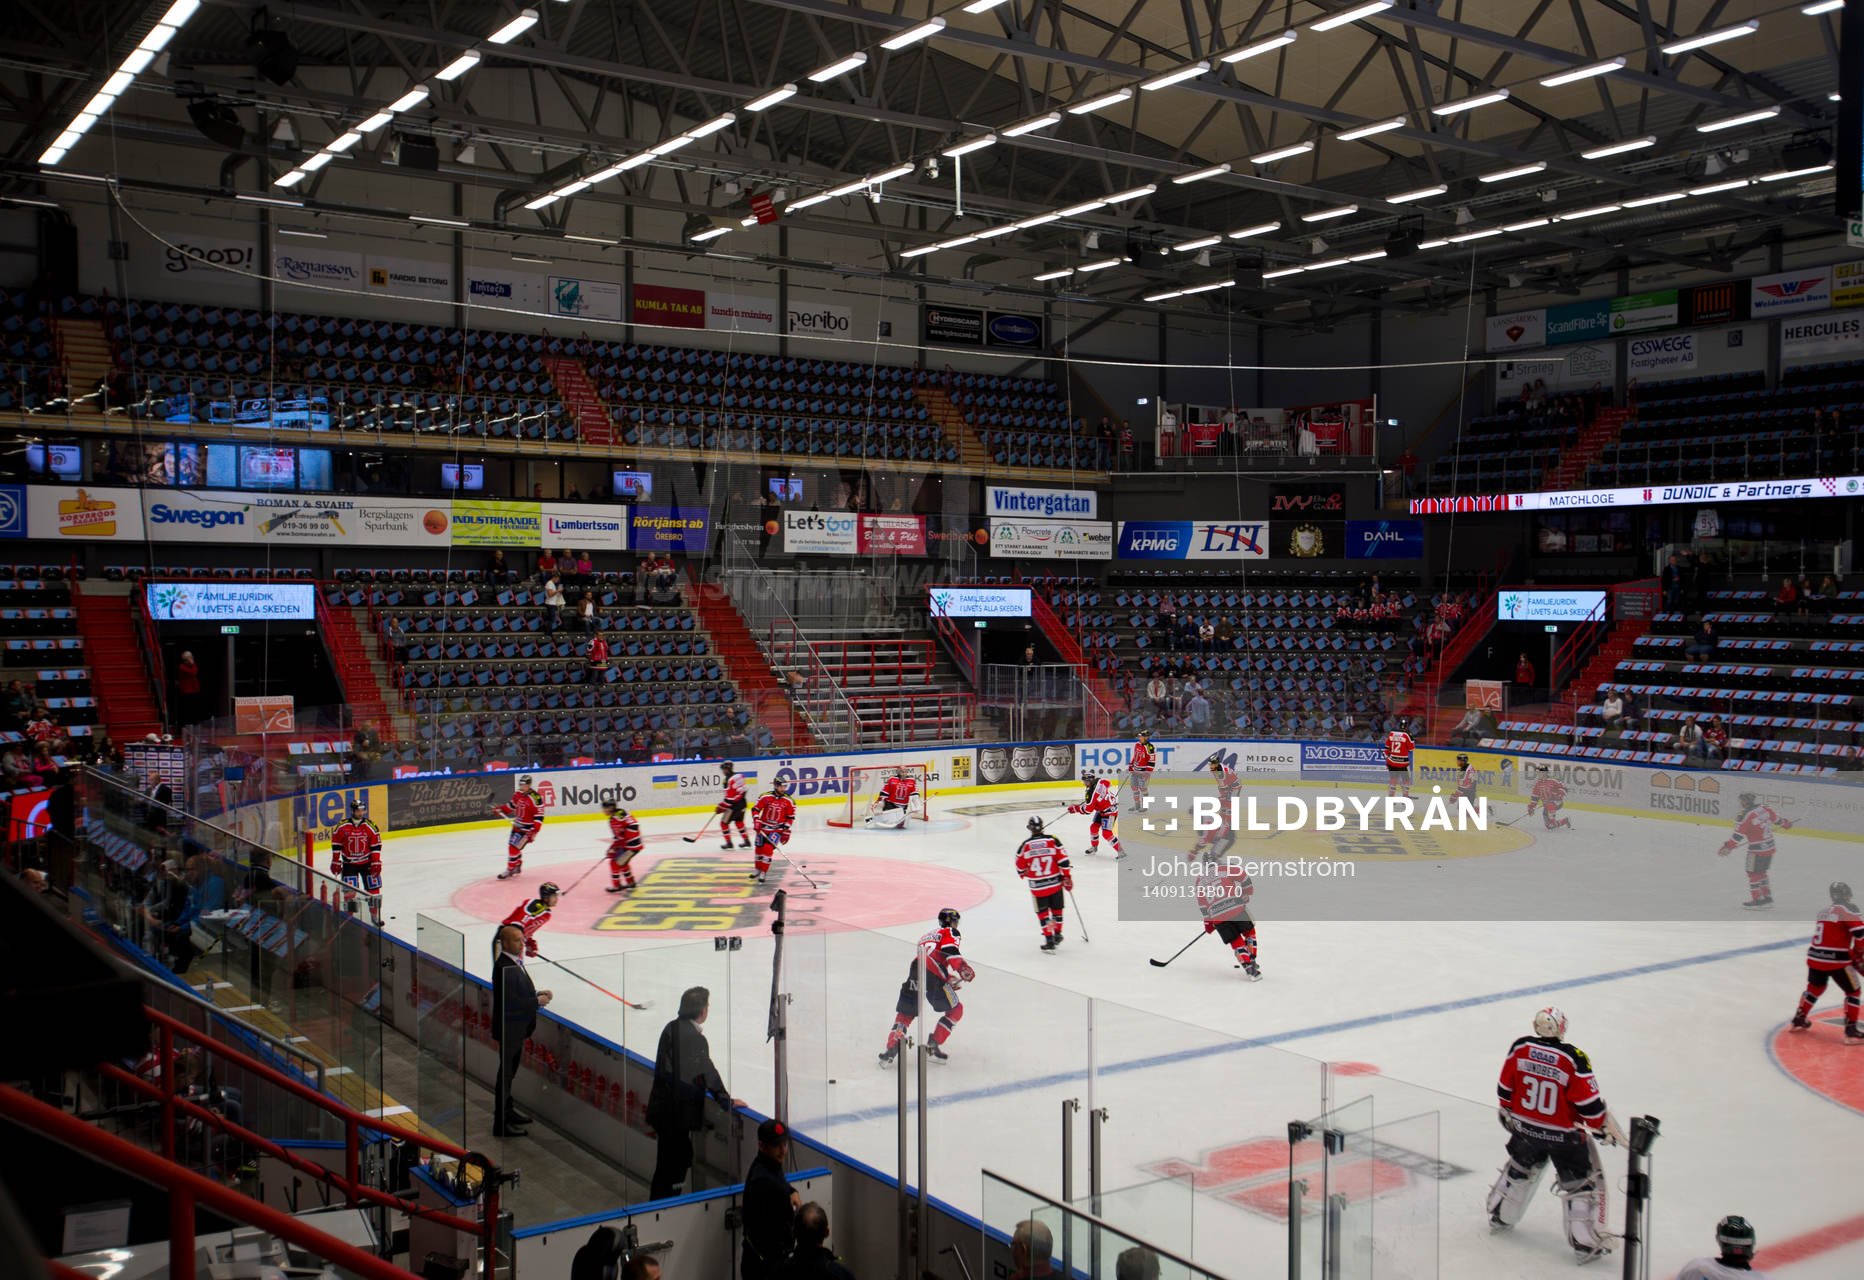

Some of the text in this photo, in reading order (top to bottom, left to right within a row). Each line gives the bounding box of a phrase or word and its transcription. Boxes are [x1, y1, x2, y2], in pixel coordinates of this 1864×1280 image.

[635, 298, 703, 314] KUMLA TAK AB
[741, 308, 772, 323] mining
[1547, 317, 1596, 335] ScandFibre
[1785, 320, 1860, 340] HERCULES
[1631, 335, 1692, 356] ESSWEGE
[1631, 355, 1679, 369] Fastigheter
[1663, 484, 1812, 500] DUNDIC & Partners
[256, 498, 354, 510] BOMAN & SVAHN
[993, 490, 1090, 515] Vintergatan
[1549, 494, 1615, 506] MATCHLOGE
[150, 503, 244, 529] Swegon
[359, 508, 414, 521] Bergslagens
[452, 515, 538, 526] INDUSTRIHANDEL
[364, 520, 408, 532] Sparbank
[555, 519, 620, 531] Lambertsson
[689, 518, 704, 529] ab
[1088, 532, 1111, 541] weber
[1202, 524, 1263, 552] LTI
[1364, 530, 1404, 542] DAHL
[1130, 538, 1178, 551] KPMG
[197, 592, 273, 602] FAMILJEJURIDIK
[236, 605, 260, 613] ALLA
[262, 605, 300, 614] SKEDEN
[1552, 608, 1567, 616] ALLA
[981, 760, 1007, 770] GOLF
[1013, 758, 1039, 769] GOLF
[1044, 756, 1071, 767] GOLF
[1246, 754, 1294, 763] MIDROC
[777, 760, 862, 796] ÖBAB
[561, 783, 636, 806] Nolato
[1650, 792, 1720, 816] EKSJÖHUS
[1030, 856, 1053, 876] 47
[1521, 1075, 1558, 1116] 30
